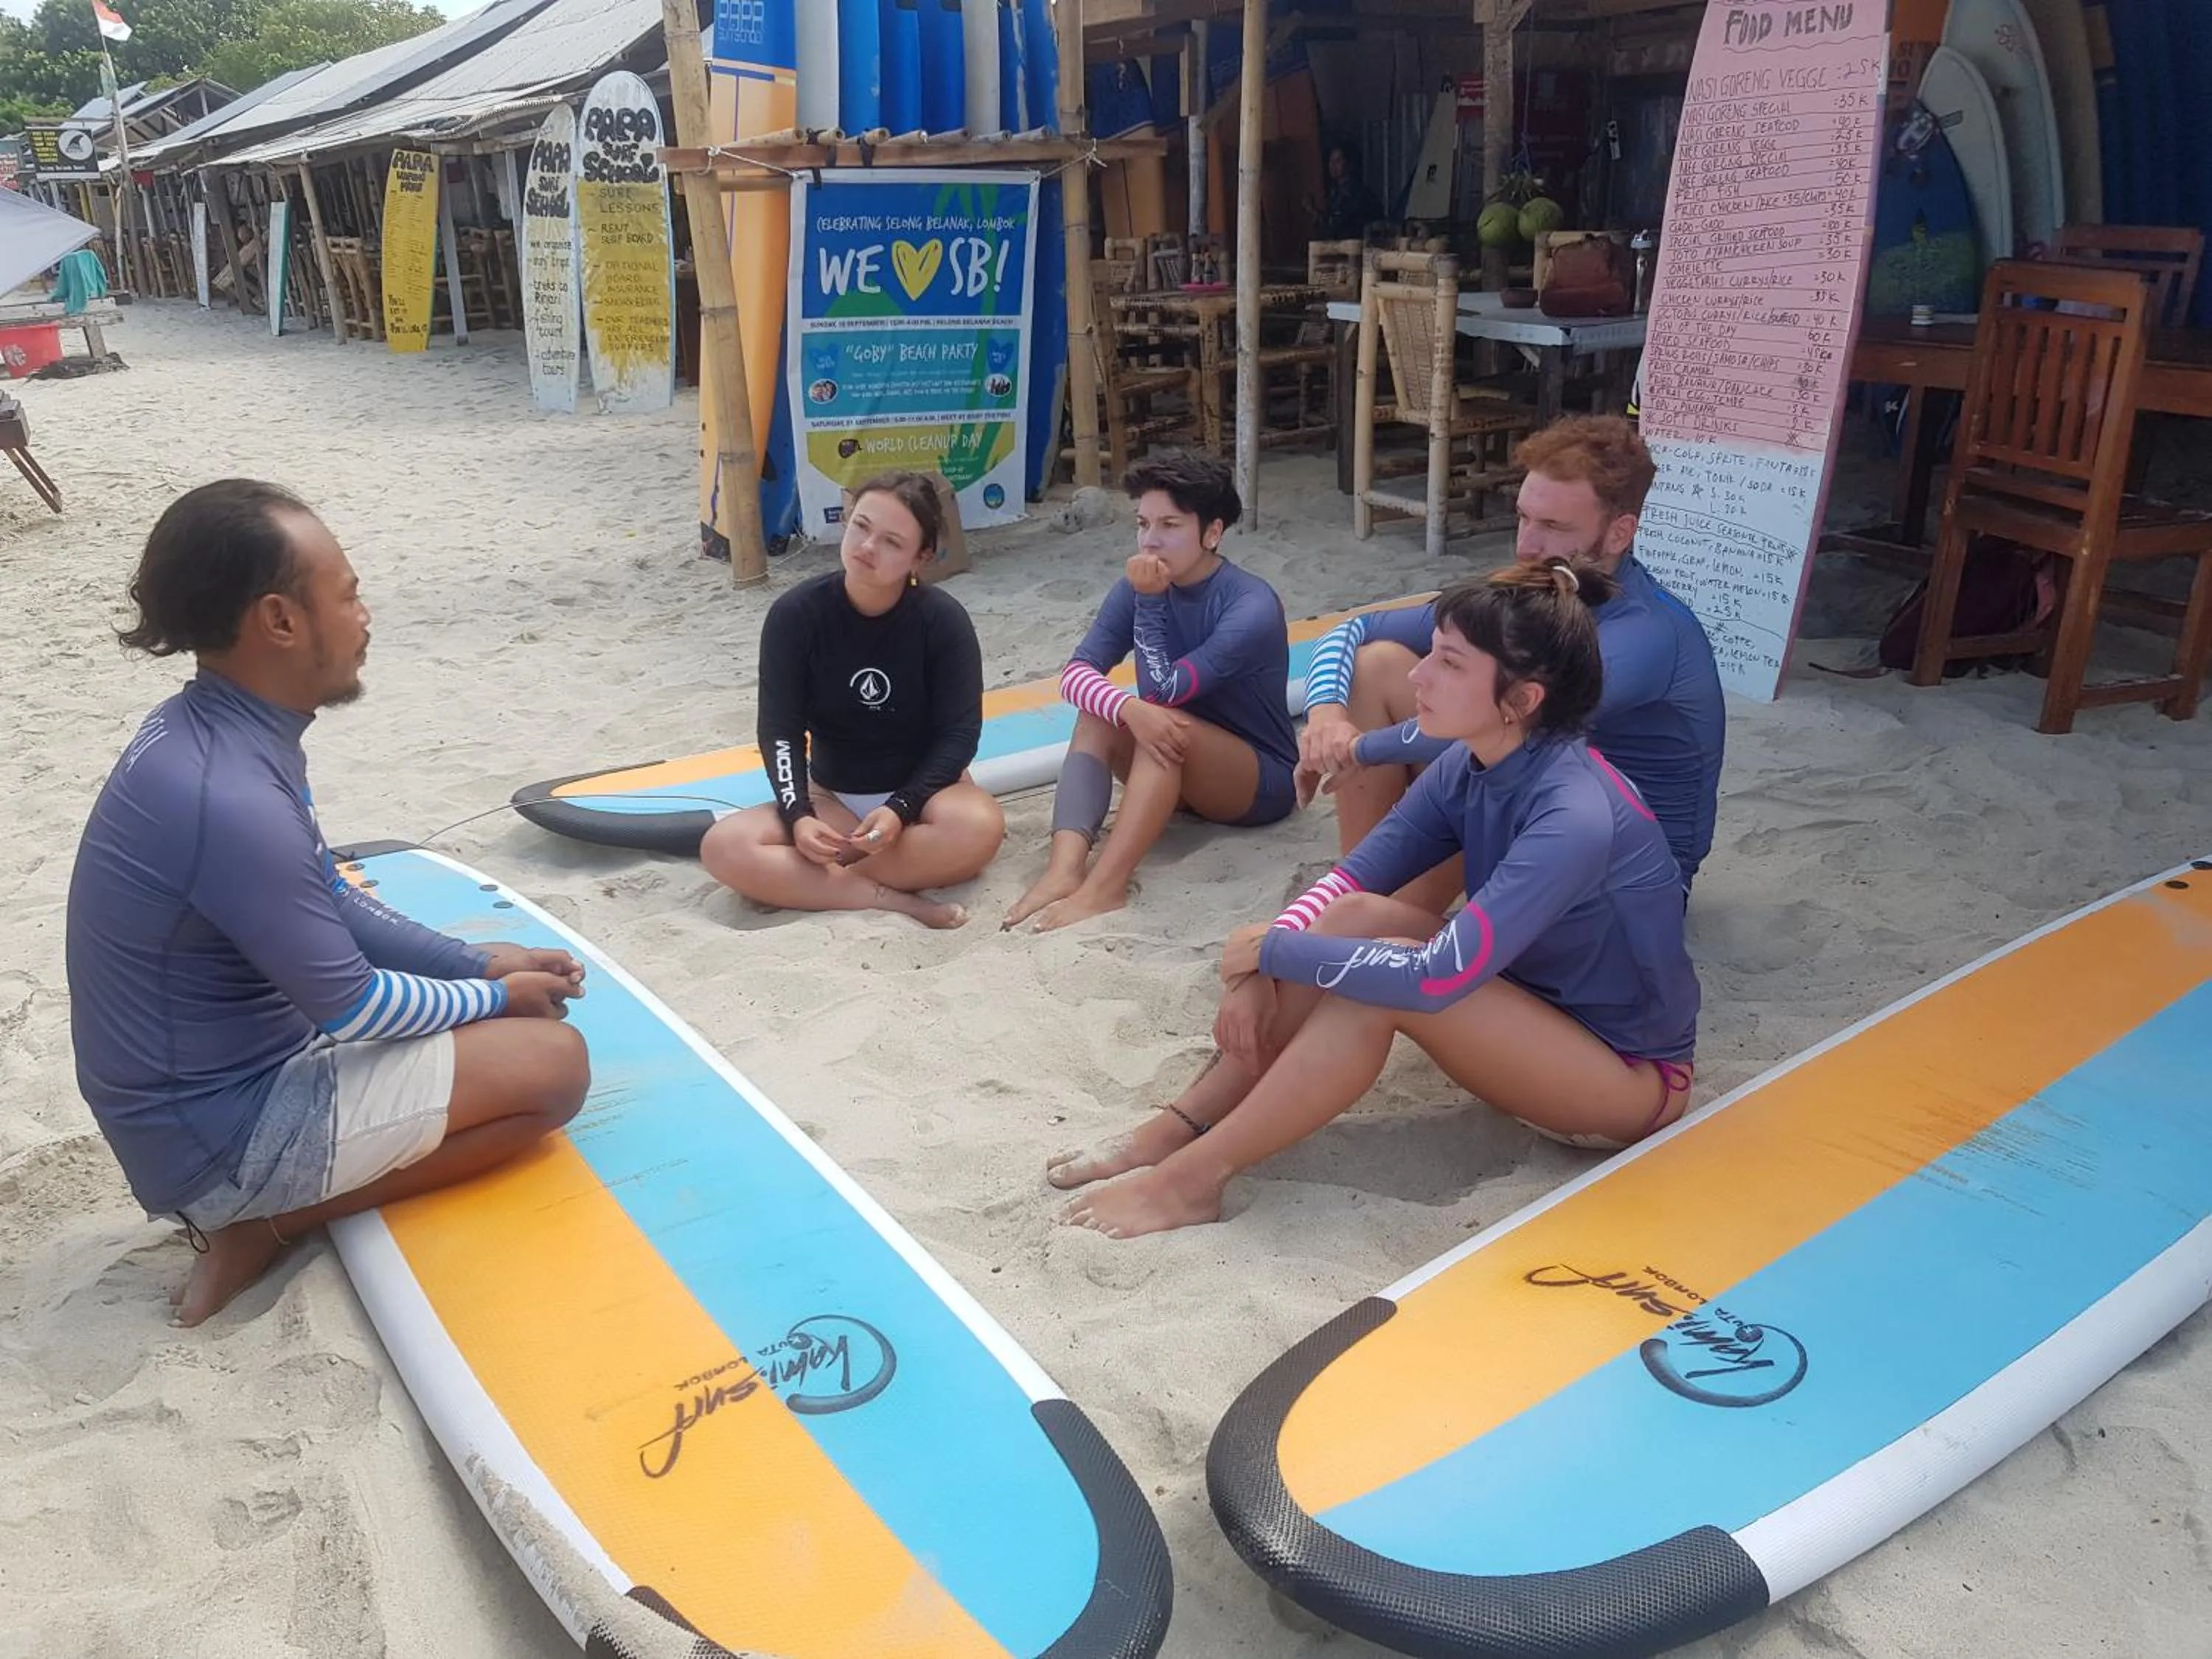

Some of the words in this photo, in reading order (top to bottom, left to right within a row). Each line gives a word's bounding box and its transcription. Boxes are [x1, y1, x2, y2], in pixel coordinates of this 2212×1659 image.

[1723, 10, 1772, 44] FOOD
[1784, 3, 1852, 37] MENU
[1688, 77, 1716, 102] NASI
[1720, 69, 1771, 96] GORENG
[585, 107, 656, 142] PAPA
[1684, 107, 1705, 125] NASI
[1708, 104, 1747, 122] GORENG
[1680, 127, 1702, 143] NASI
[1706, 125, 1745, 140] GORENG
[1753, 119, 1800, 133] SEAFOOD
[532, 139, 571, 173] PAPA
[602, 142, 639, 162] SURF
[1701, 141, 1741, 158] GORENG
[1701, 156, 1742, 171] GORENG
[1745, 164, 1790, 179] SEAFOOD
[600, 203, 661, 214] LESSONS
[602, 223, 628, 234] RENT
[817, 215, 881, 233] CELEBRATING
[886, 215, 922, 231] SELONG
[976, 215, 1015, 231] LOMBOK
[819, 244, 884, 296] WE
[949, 237, 1010, 298] SB!
[900, 342, 937, 362] BEACH
[942, 342, 978, 361] PARTY
[1659, 411, 1686, 424] SOFT
[1694, 414, 1738, 431] DRINKS
[866, 437, 904, 454] WORLD
[908, 434, 958, 453] CLEANUP
[961, 432, 983, 449] DAY
[1645, 428, 1680, 439] WATER
[1684, 515, 1711, 529] JUICE
[1643, 1266, 1708, 1304] LOMBOK
[672, 1356, 750, 1391] LOMBOK
